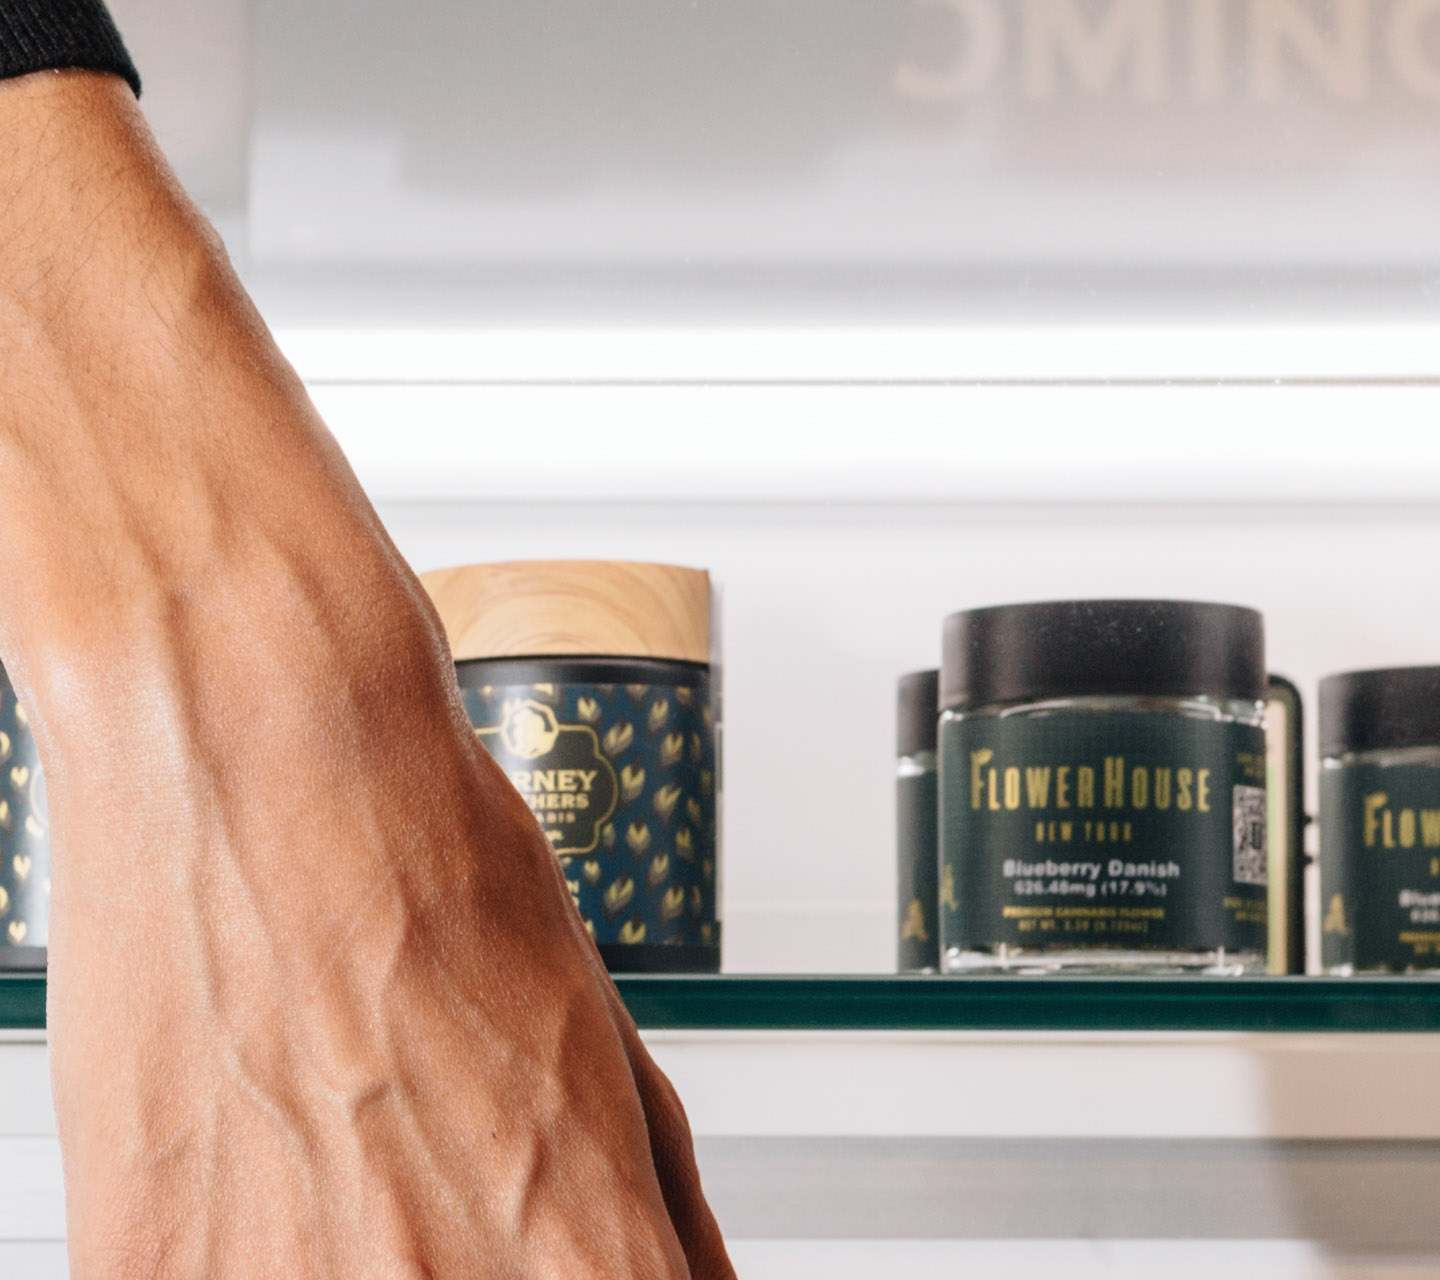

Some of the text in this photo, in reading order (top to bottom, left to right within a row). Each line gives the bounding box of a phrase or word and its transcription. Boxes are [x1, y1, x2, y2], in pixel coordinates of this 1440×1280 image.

[511, 769, 598, 792] RNEY
[527, 792, 590, 809] HERS
[1002, 859, 1181, 880] Blueberry Danish
